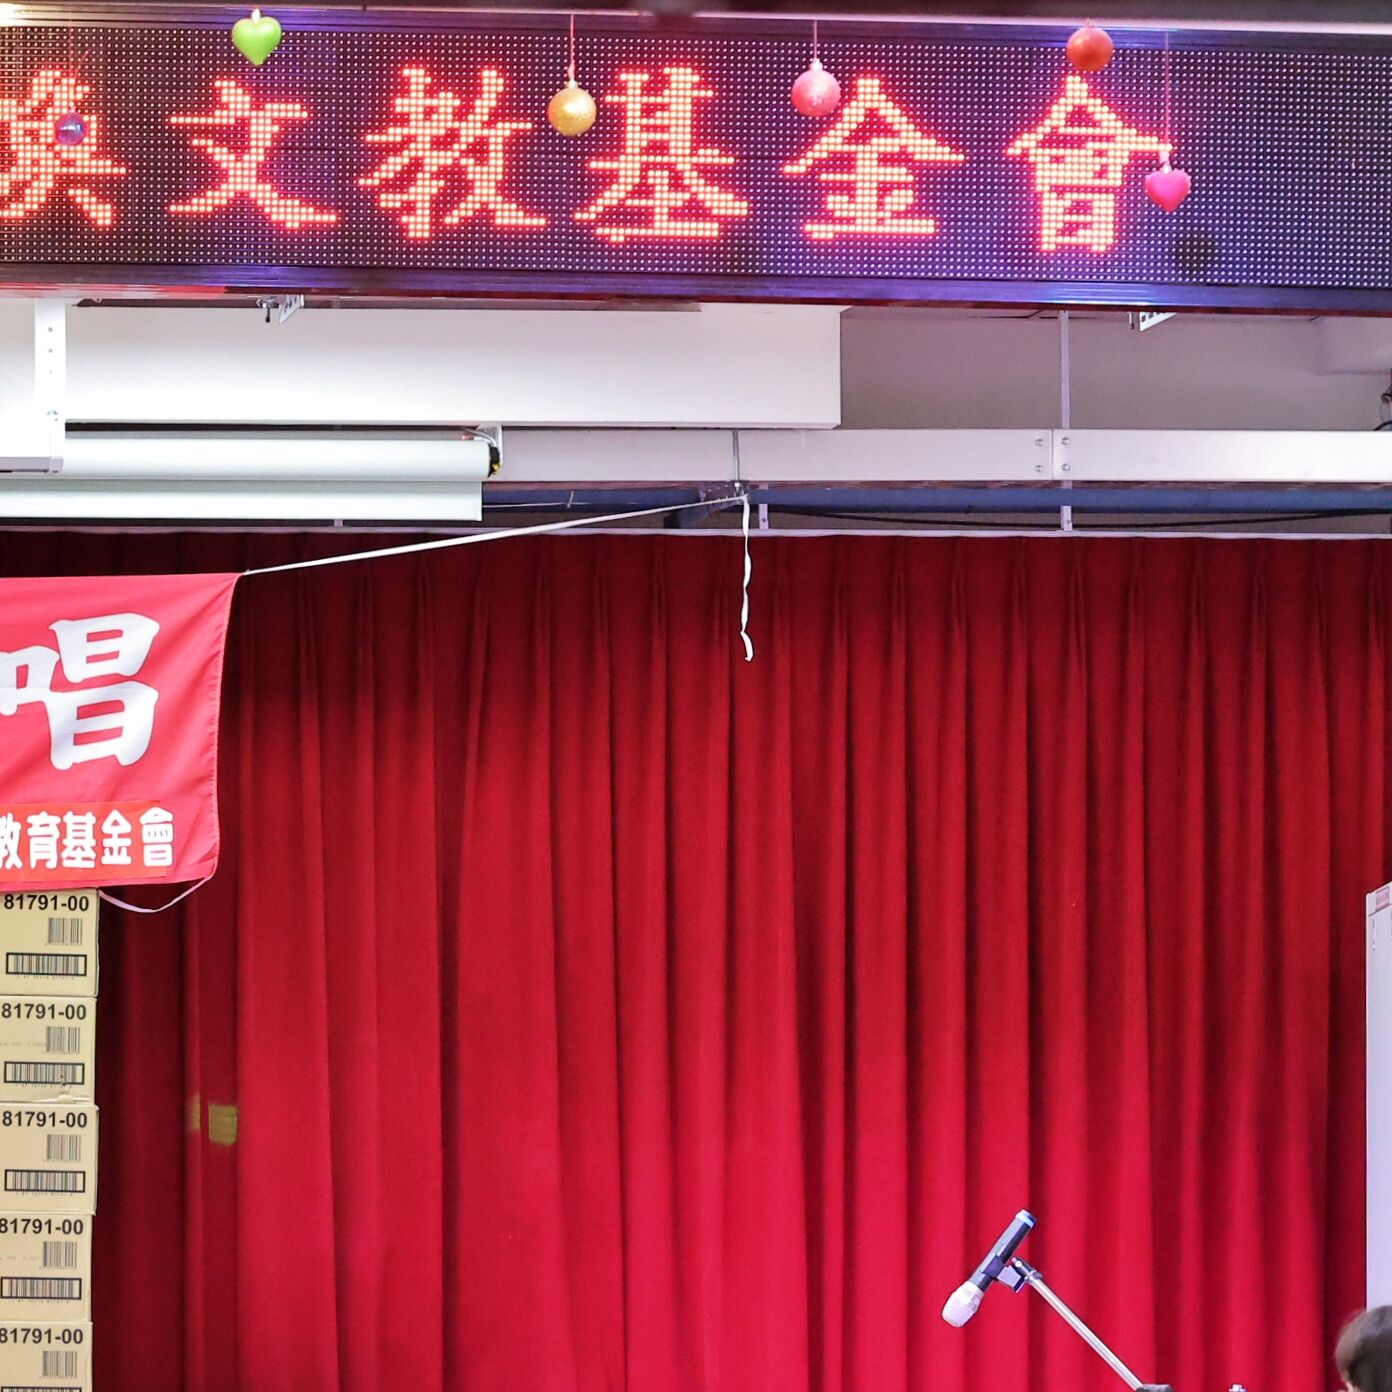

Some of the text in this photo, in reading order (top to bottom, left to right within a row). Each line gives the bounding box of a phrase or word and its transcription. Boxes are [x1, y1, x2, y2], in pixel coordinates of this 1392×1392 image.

[3, 894, 89, 911] 81791-00
[1, 1003, 87, 1020] 81791-00
[2, 1111, 88, 1128] 81791-00
